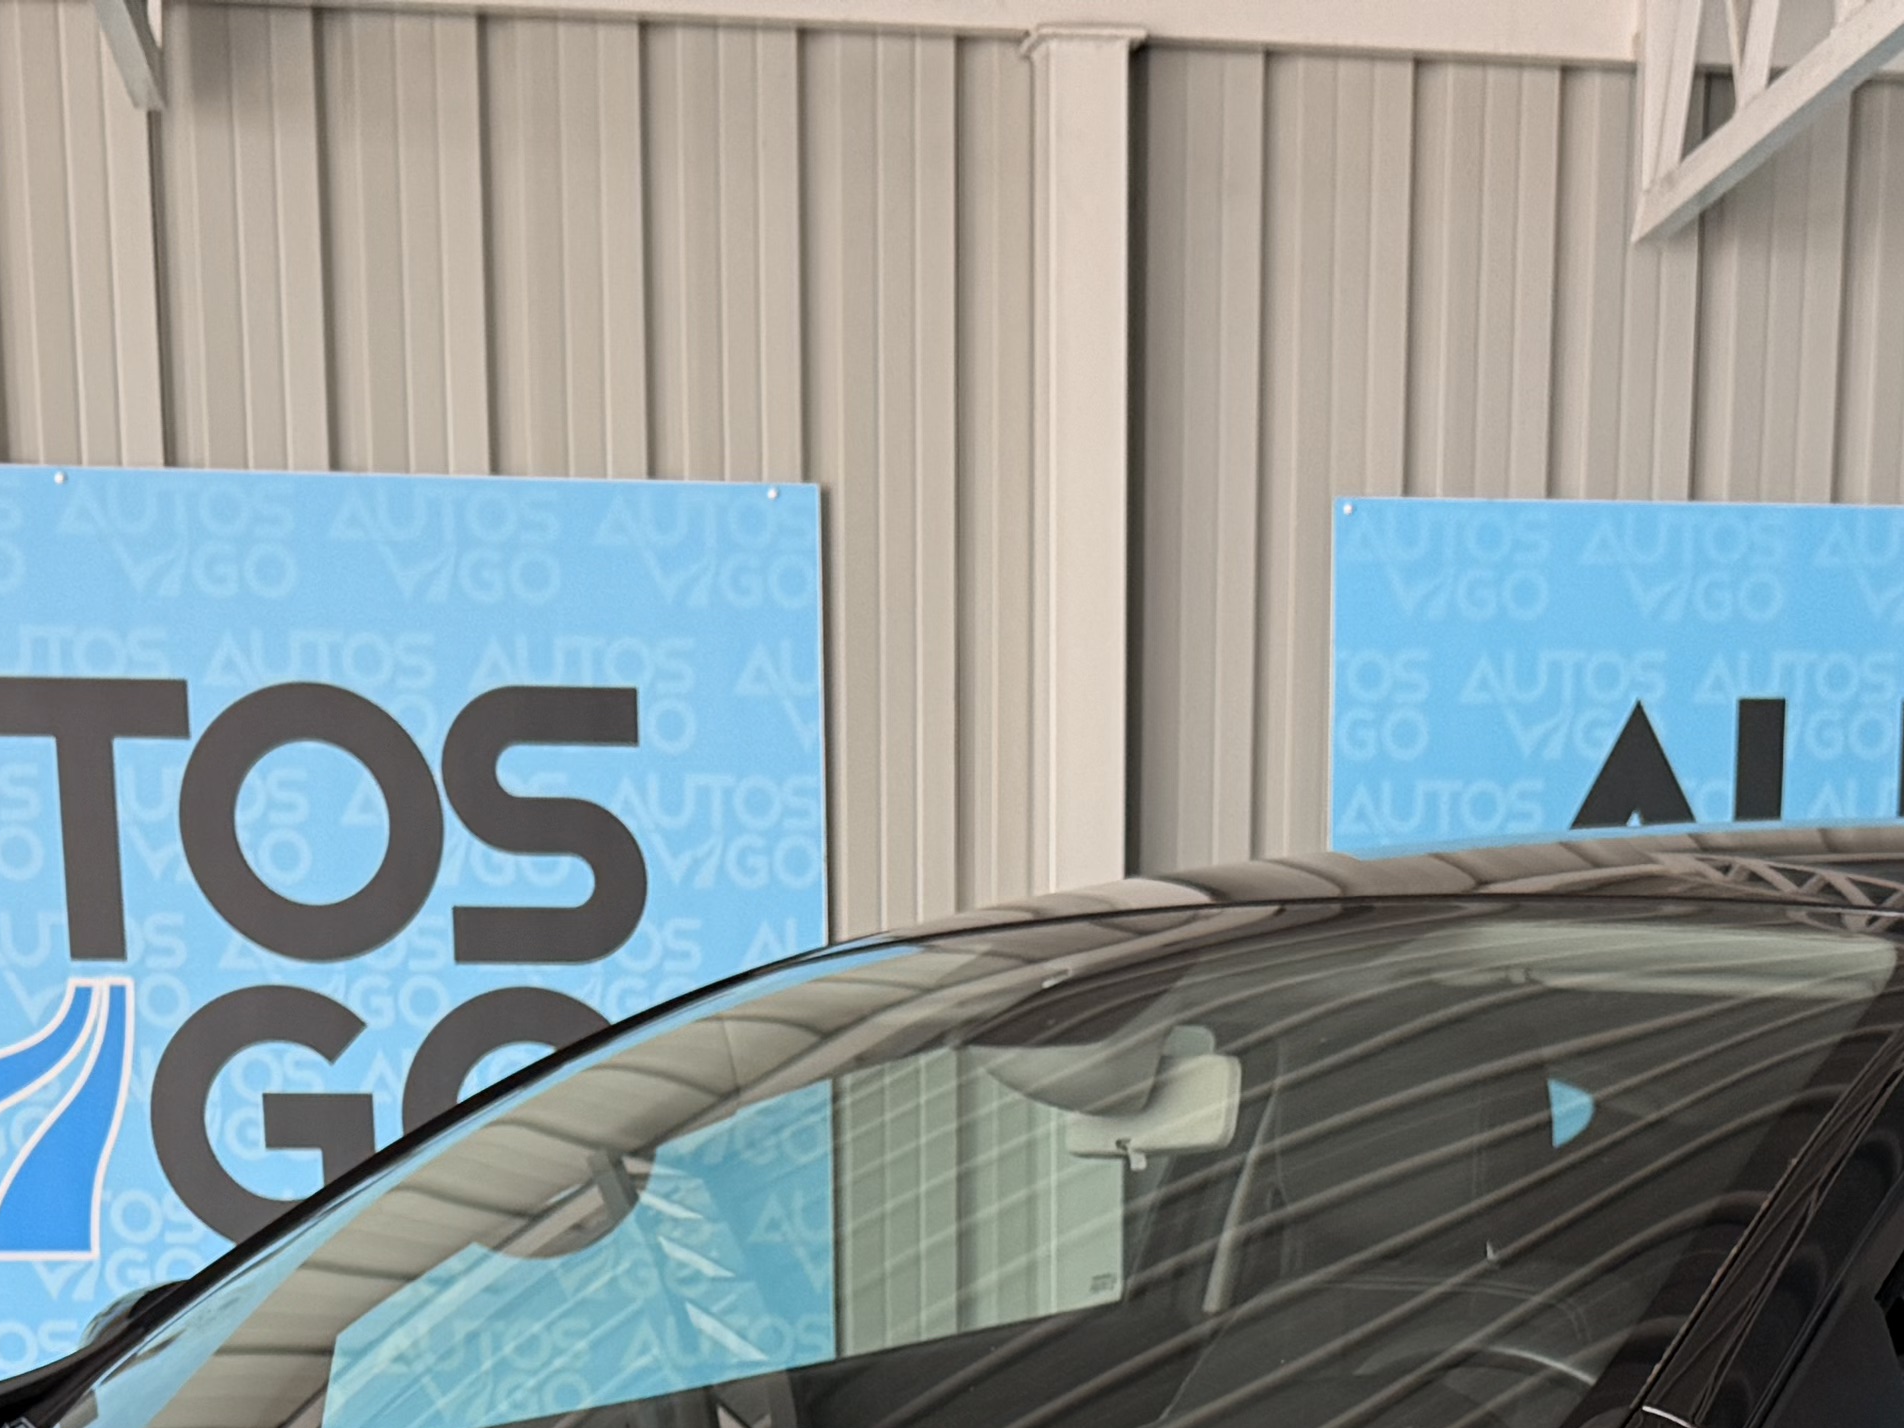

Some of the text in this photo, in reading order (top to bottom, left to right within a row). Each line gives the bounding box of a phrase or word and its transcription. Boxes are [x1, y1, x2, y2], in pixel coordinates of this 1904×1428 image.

[56, 480, 295, 537] AUTOS
[328, 486, 561, 546] AUTOS
[110, 536, 299, 598] VIGO
[381, 547, 562, 602] VIGO
[1460, 649, 1668, 704] AUTOS
